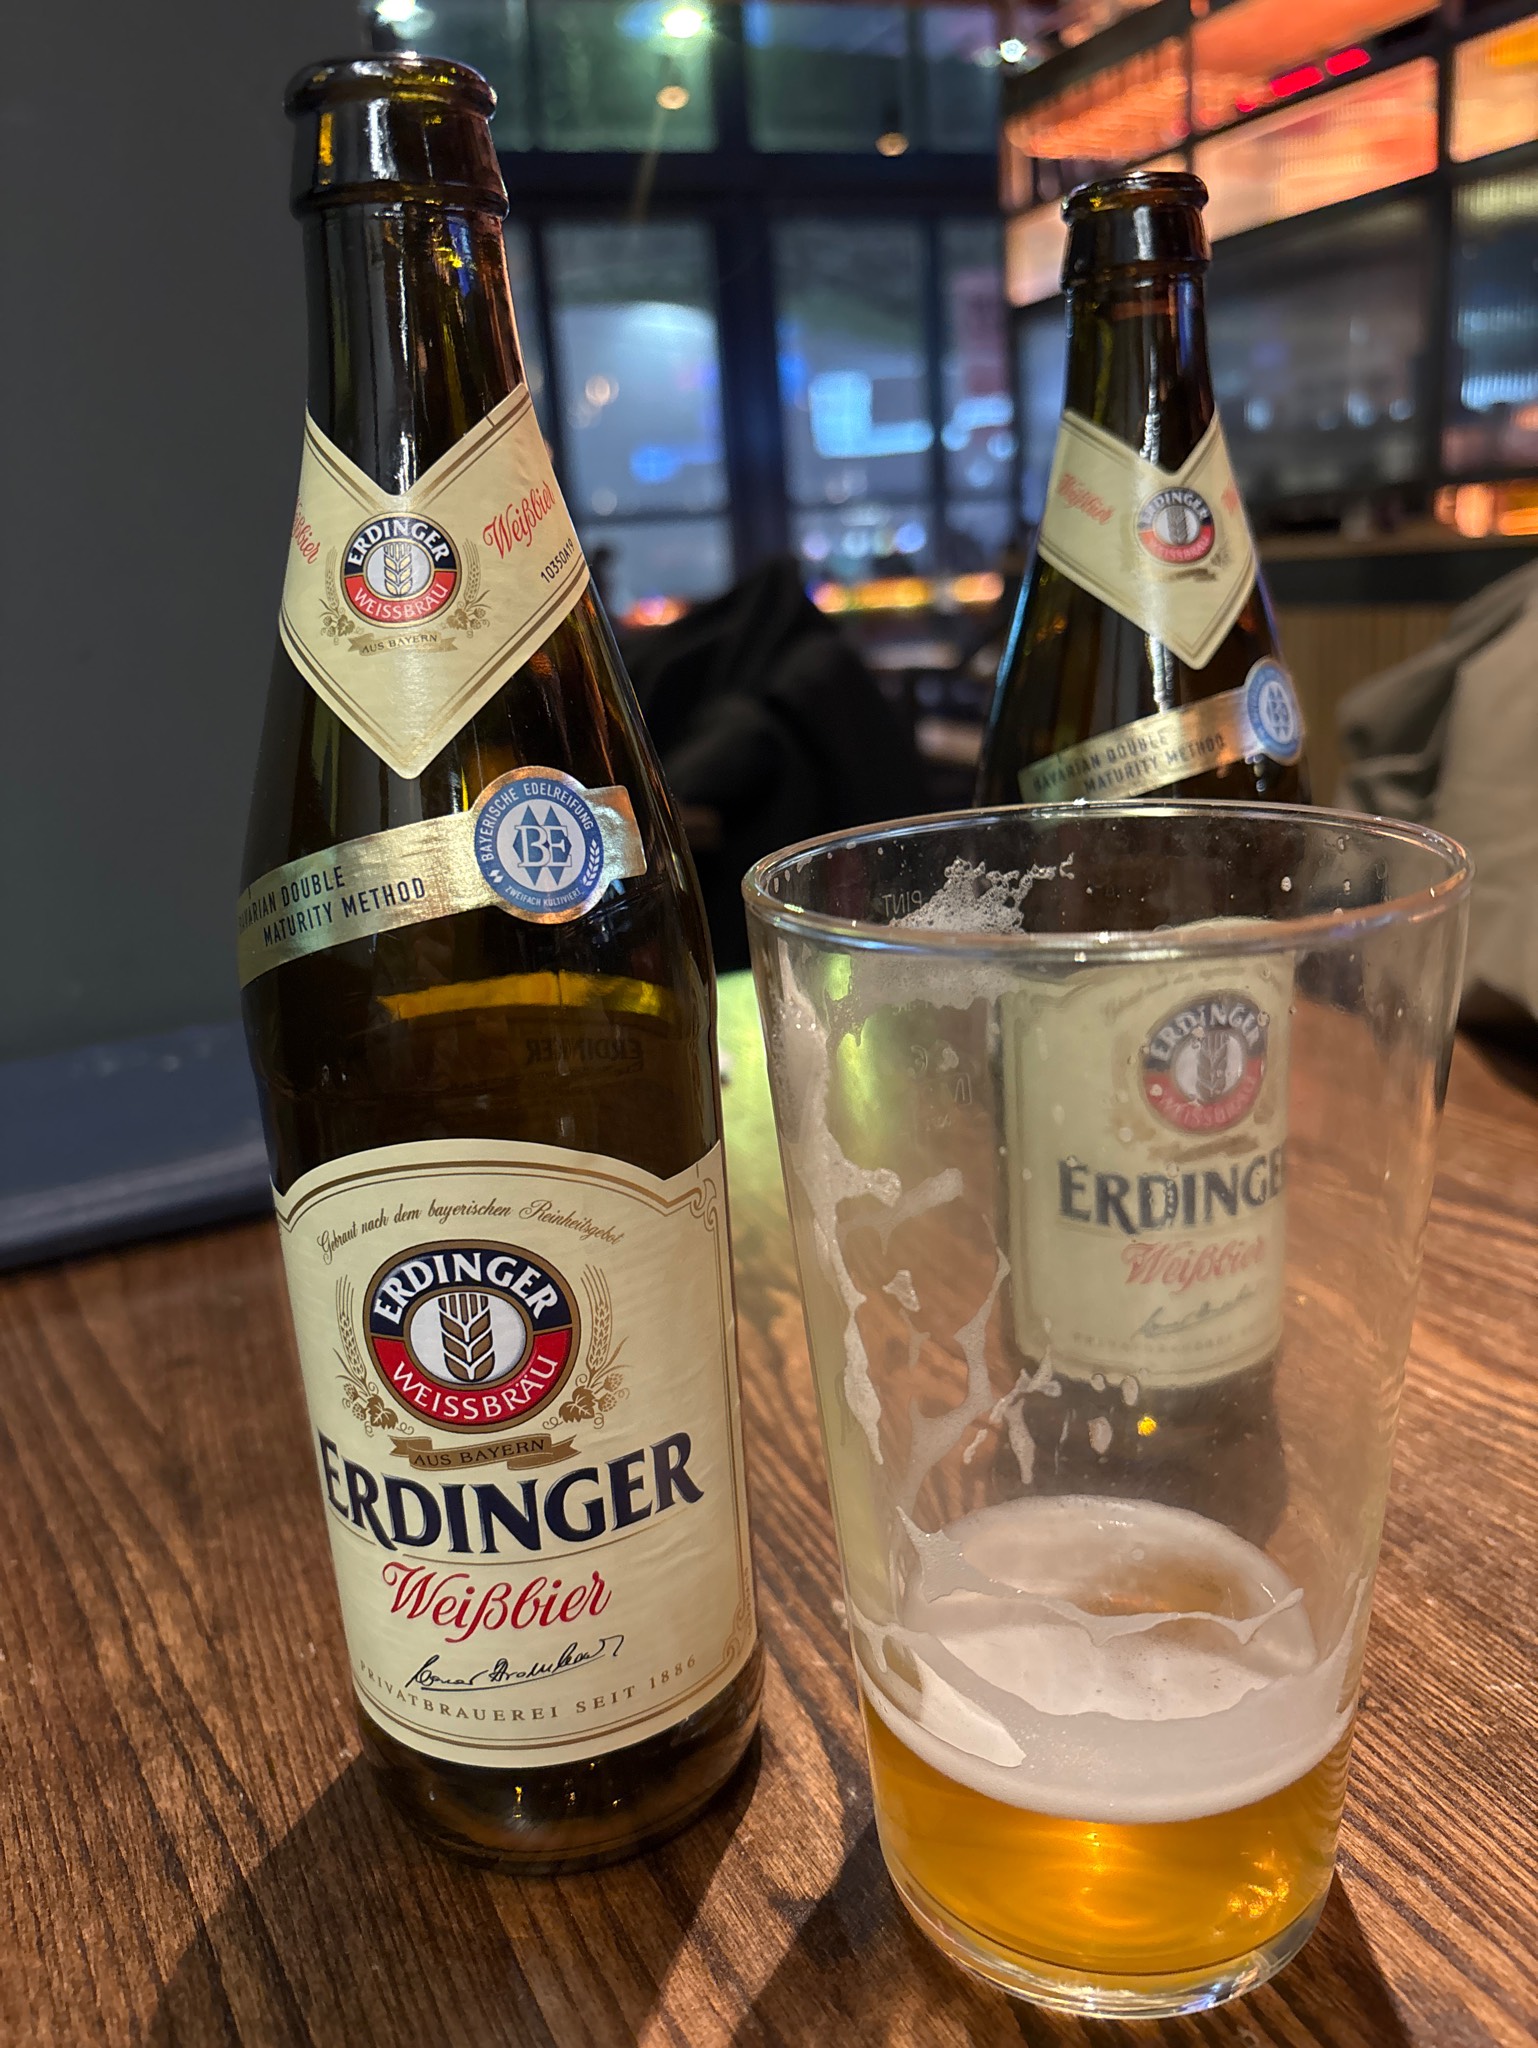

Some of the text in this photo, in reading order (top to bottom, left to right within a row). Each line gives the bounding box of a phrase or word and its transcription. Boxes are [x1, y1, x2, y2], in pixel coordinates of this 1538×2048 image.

[347, 519, 451, 566] ERDINGER
[482, 480, 556, 560] Weißbier
[353, 582, 449, 620] WEISSBRÄU
[360, 633, 438, 654] AUS BAYERN
[479, 782, 594, 862] BAYERISCHE EDELREIFUNG
[263, 877, 426, 947] MATURITY METHOD
[281, 866, 346, 907] DOUBLE
[505, 885, 541, 906] ZWEIFACH
[317, 1198, 626, 1265] Gebraut nach dem bayerischen Reinheitsgebot
[374, 1252, 559, 1324] ERDINGER
[393, 1355, 559, 1420] WEISSBRÄU
[413, 1438, 545, 1467] AUS BAYERN
[317, 1431, 705, 1555] ERDINGER
[382, 1560, 613, 1644] Weißbier
[359, 1660, 559, 1722] PRIVATBRAUEREI
[576, 1684, 637, 1714] SEIT
[648, 1654, 697, 1690] 1886
